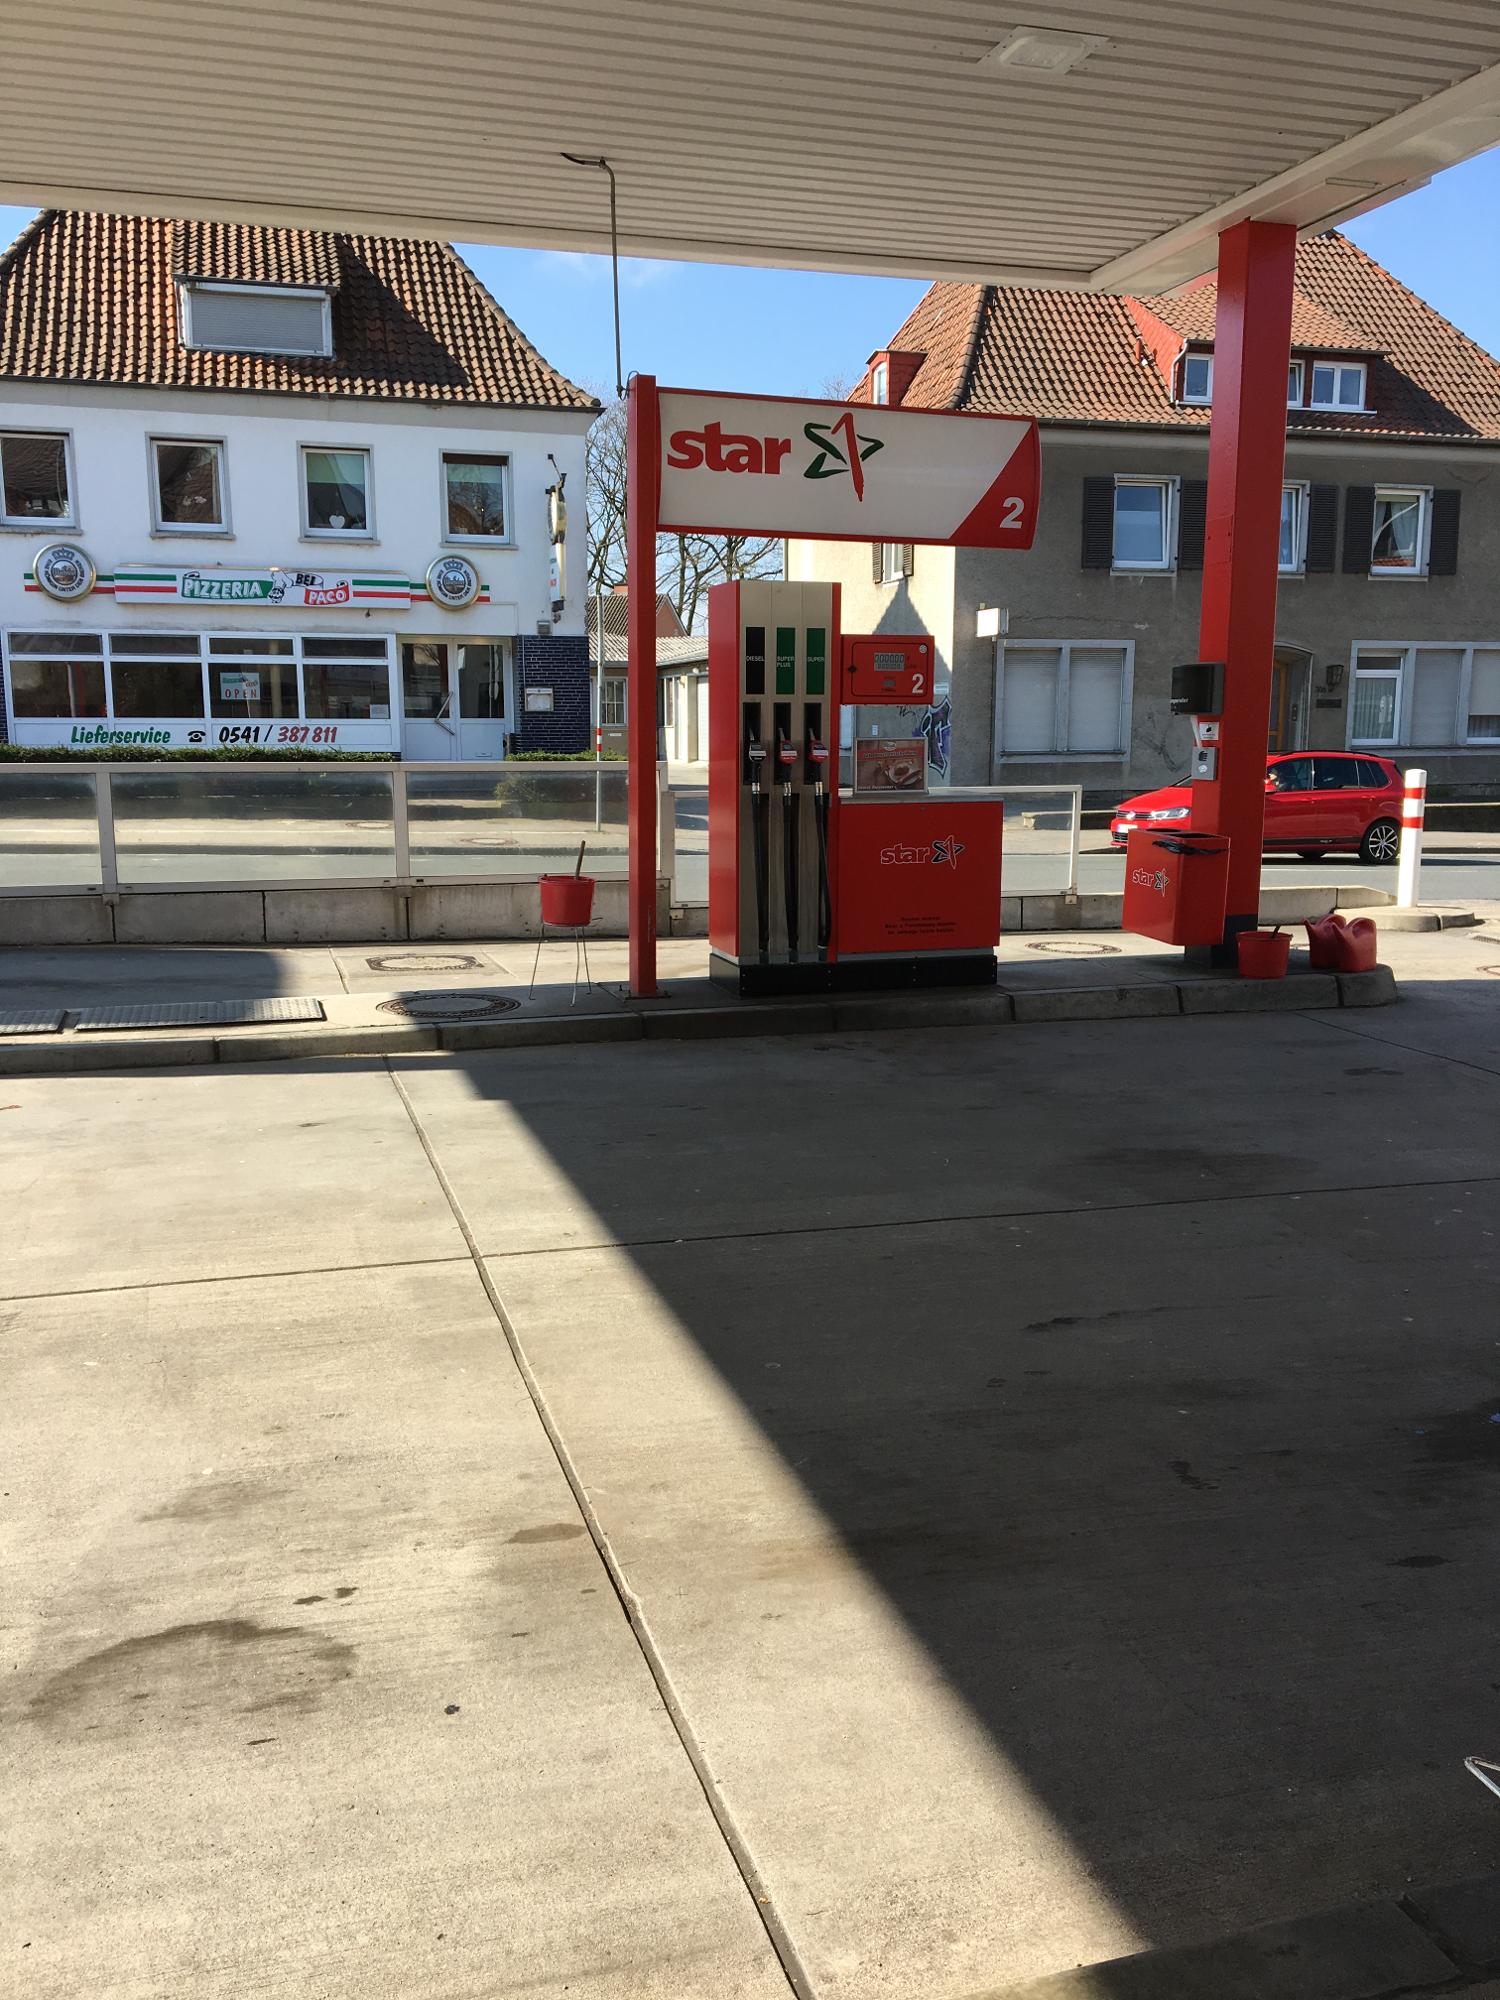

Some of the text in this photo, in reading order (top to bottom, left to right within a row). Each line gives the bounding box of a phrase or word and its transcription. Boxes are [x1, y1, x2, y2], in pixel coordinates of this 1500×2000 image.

[667, 421, 791, 475] star
[1000, 497, 1025, 529] 2
[183, 578, 264, 599] PIZZERIA
[308, 589, 347, 604] PACO
[225, 688, 257, 698] OPEN
[912, 673, 924, 694] 2
[71, 724, 171, 743] Lieferservice
[218, 725, 260, 743] 0541
[880, 843, 930, 865] star
[1132, 868, 1154, 887] star
